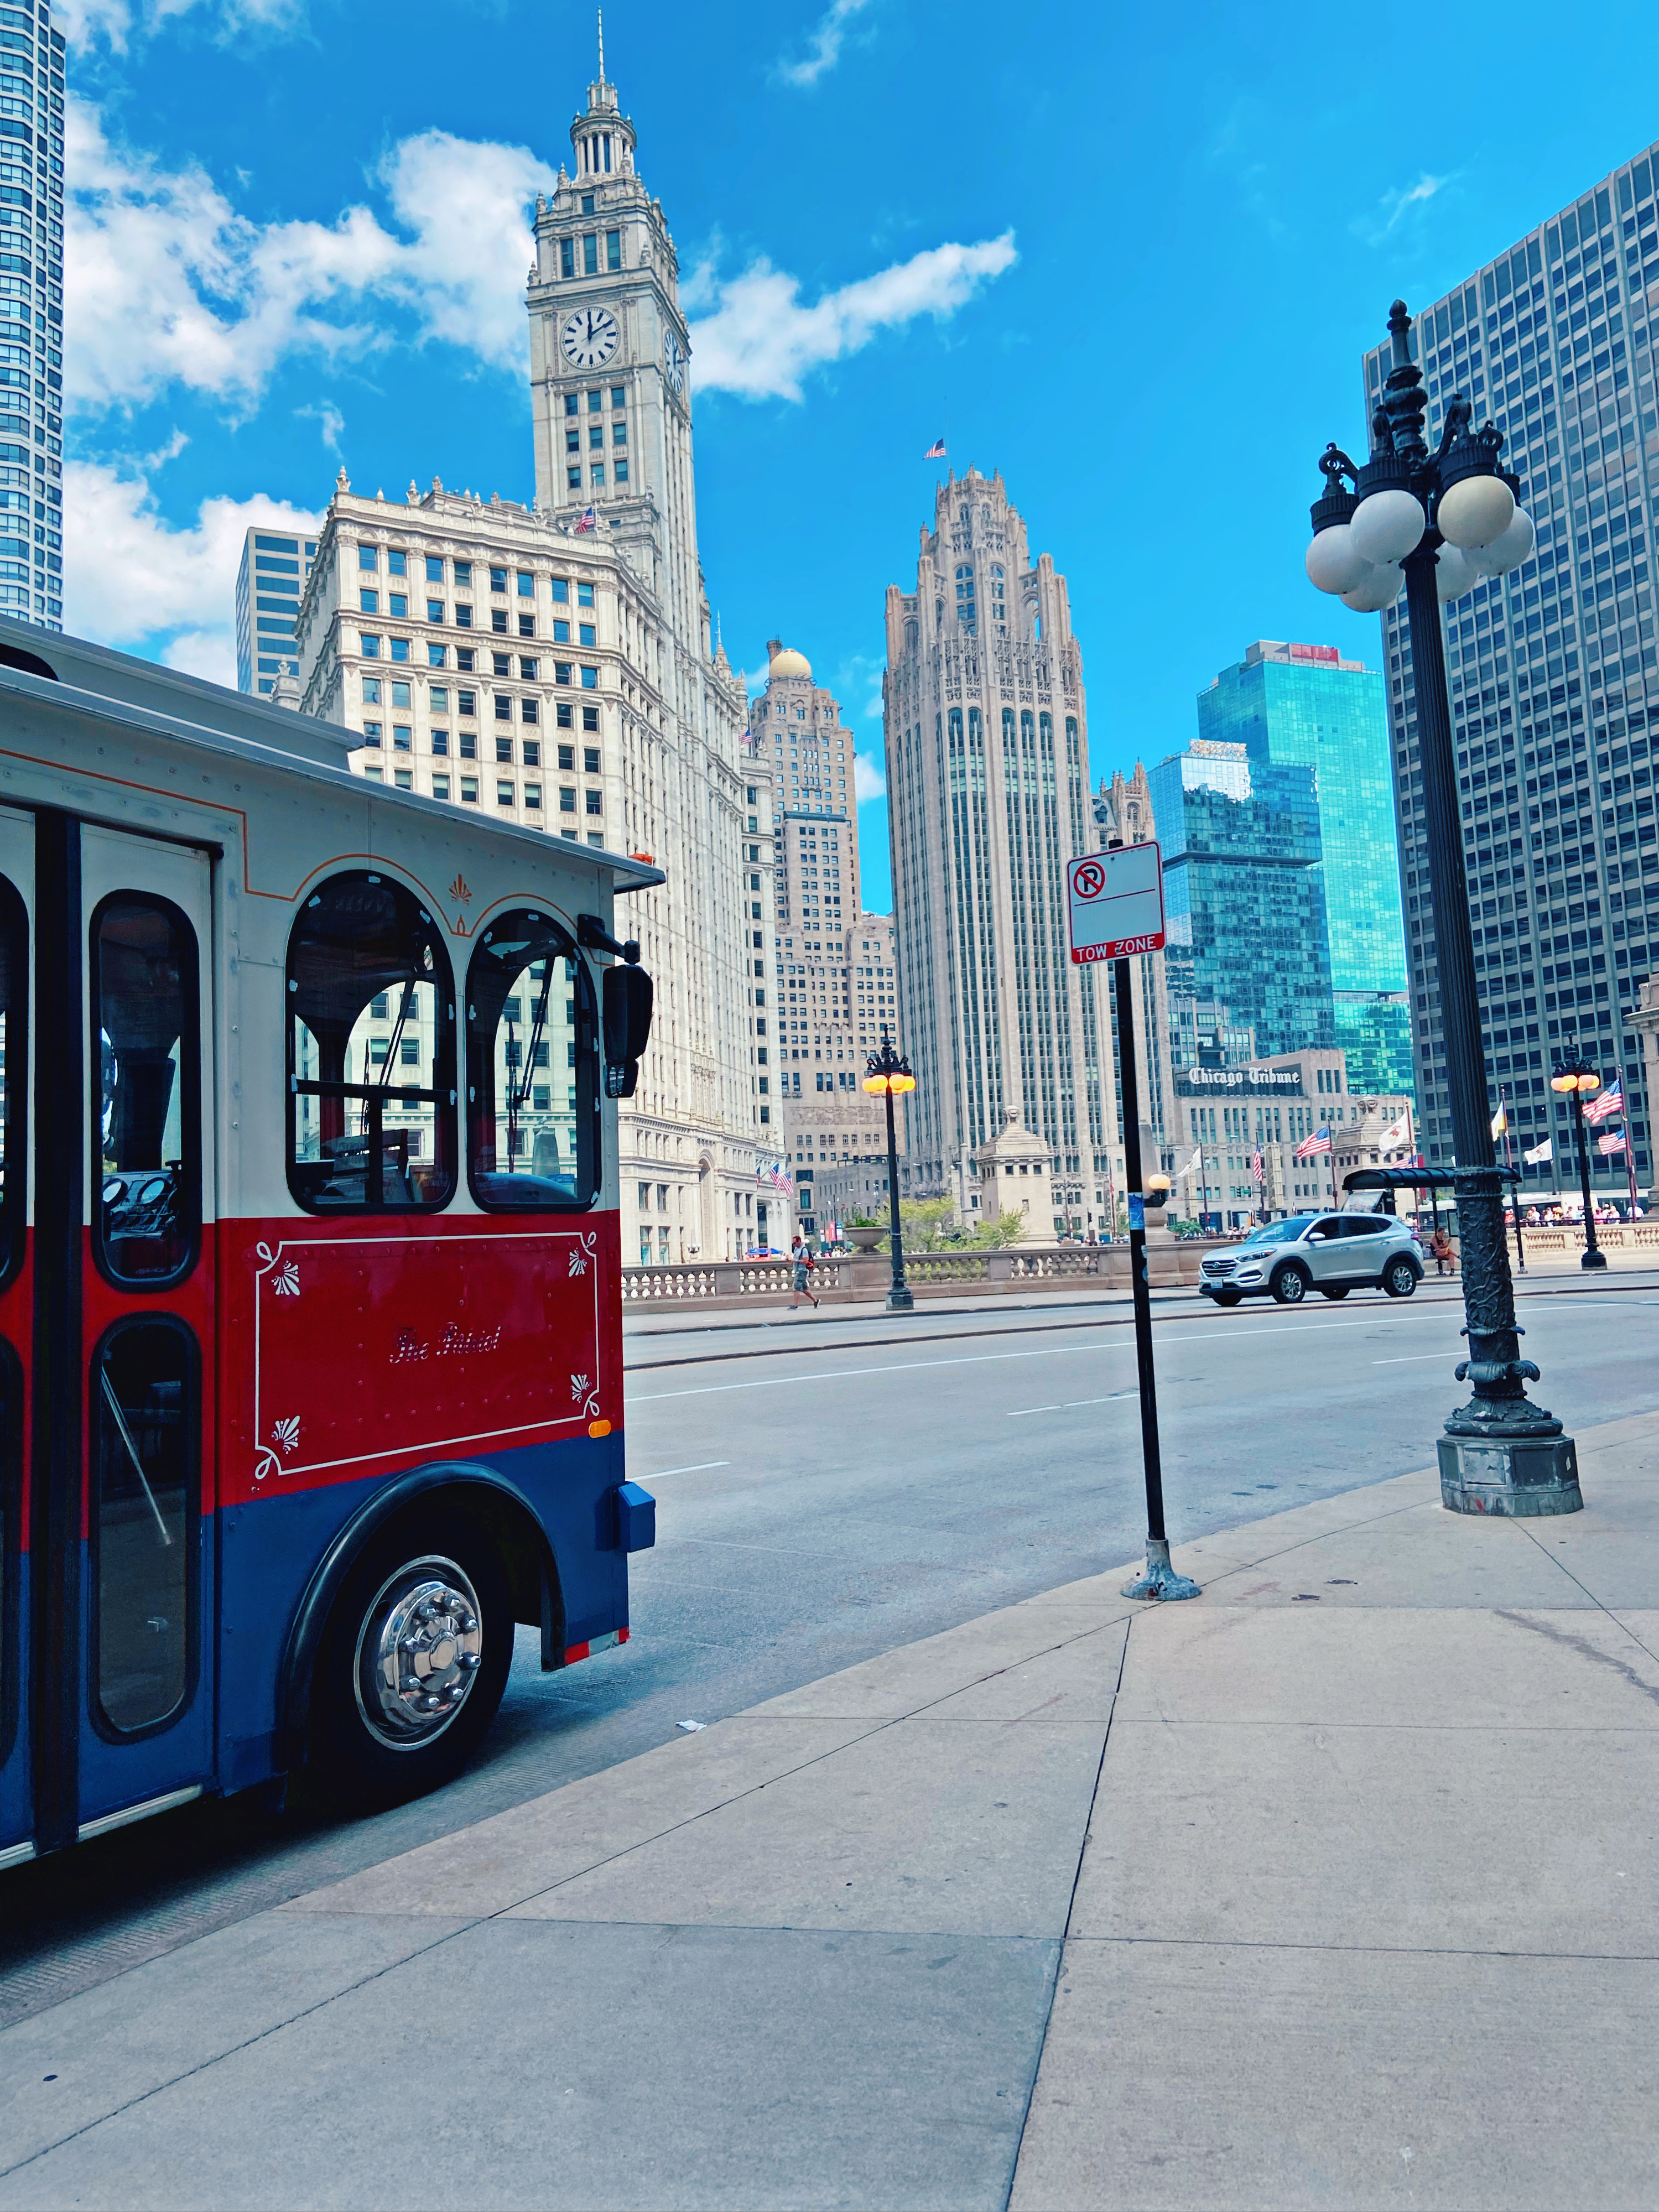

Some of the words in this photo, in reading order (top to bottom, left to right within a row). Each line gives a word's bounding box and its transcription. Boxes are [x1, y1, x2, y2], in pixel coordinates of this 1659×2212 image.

[1076, 944, 1107, 962] TOW
[1115, 935, 1157, 955] ZONE
[1188, 1066, 1244, 1087] Chicago
[1248, 1066, 1300, 1085] Tribune
